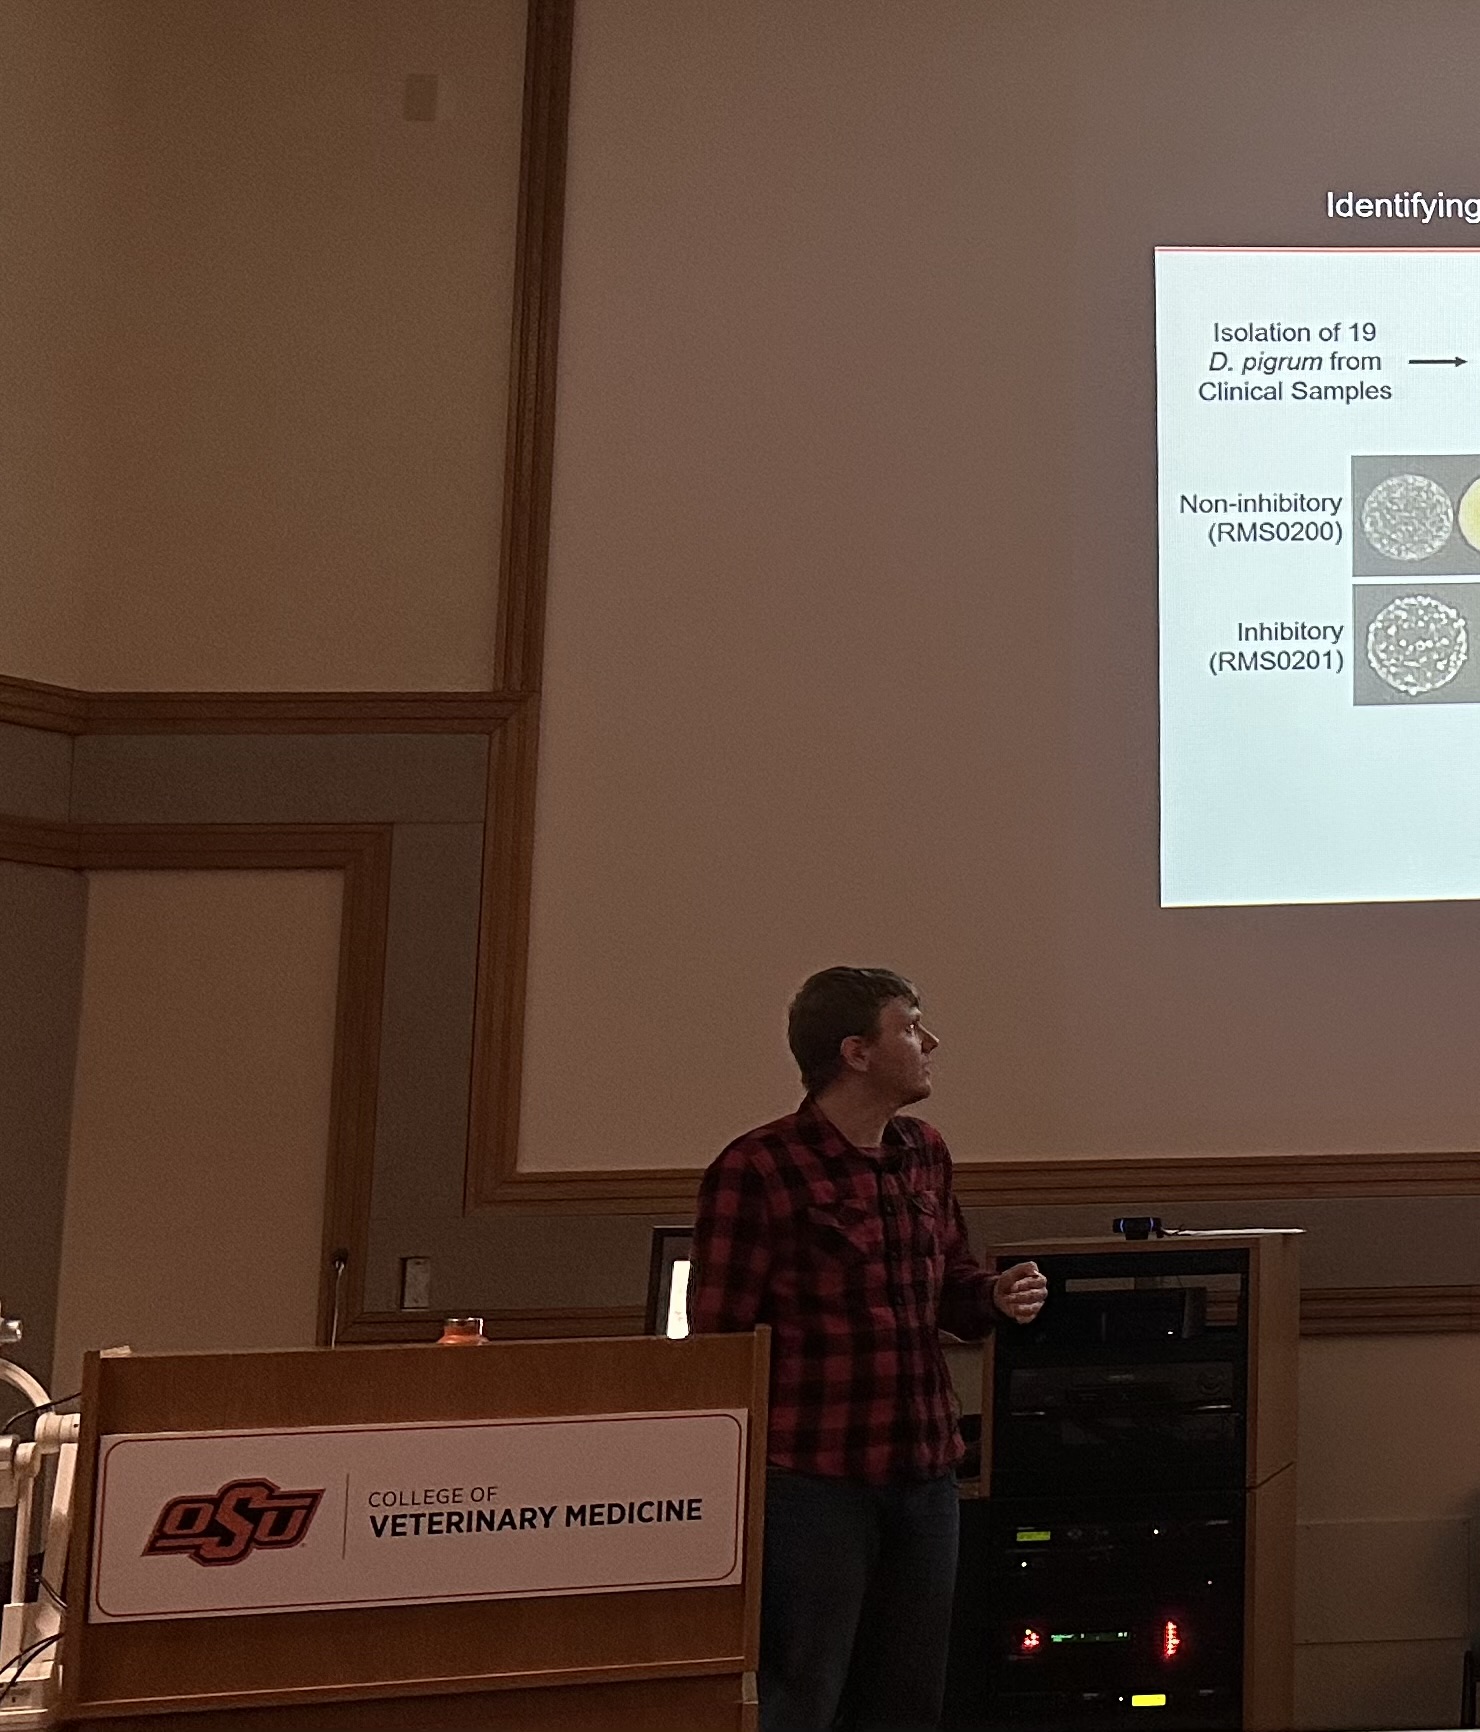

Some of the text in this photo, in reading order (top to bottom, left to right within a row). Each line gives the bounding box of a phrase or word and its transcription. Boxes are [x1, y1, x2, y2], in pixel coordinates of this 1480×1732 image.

[1214, 322, 1377, 343] Isolation of 19
[1208, 351, 1382, 378] D. pigrum from
[1198, 381, 1393, 405] Clinical Samples
[1179, 493, 1343, 516] Non-inhibitory
[1207, 521, 1344, 547] (RMS0200)
[1237, 621, 1345, 646] Inhibitory
[1208, 649, 1345, 676] (RMS0201)
[368, 1486, 498, 1508] COLLEGE OF
[141, 1478, 327, 1567] OSU
[369, 1498, 703, 1538] VETERINARY MEDICINE
